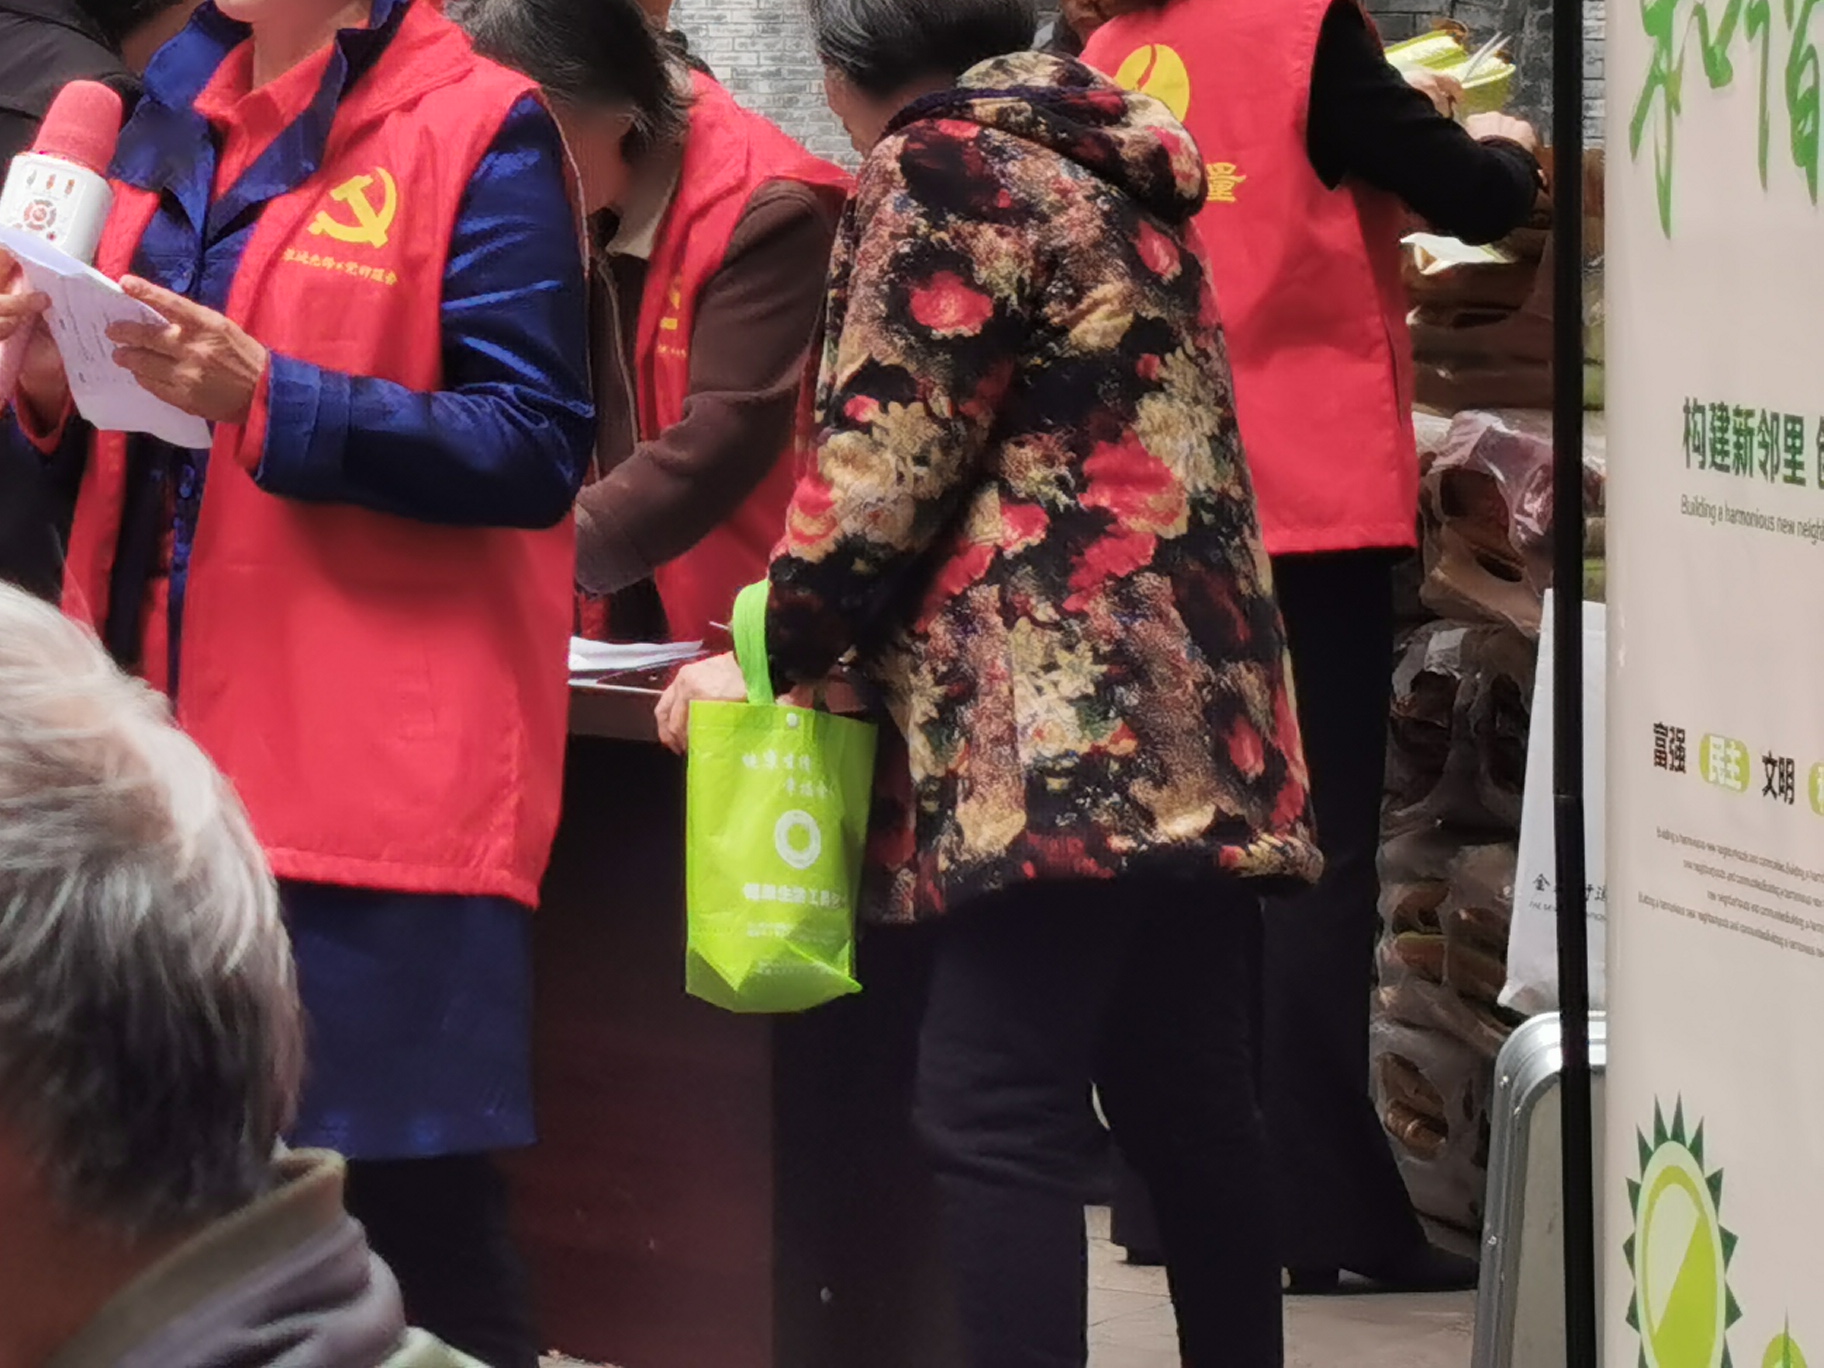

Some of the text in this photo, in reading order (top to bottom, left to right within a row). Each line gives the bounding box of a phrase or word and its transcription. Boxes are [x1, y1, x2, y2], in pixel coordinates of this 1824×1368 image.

[1683, 396, 1806, 487] 构建新邻里
[1680, 493, 1717, 526] Building
[1725, 499, 1776, 532] harmonious
[1776, 516, 1795, 535] new
[1708, 735, 1743, 791] 民主
[1762, 750, 1795, 805] 文明
